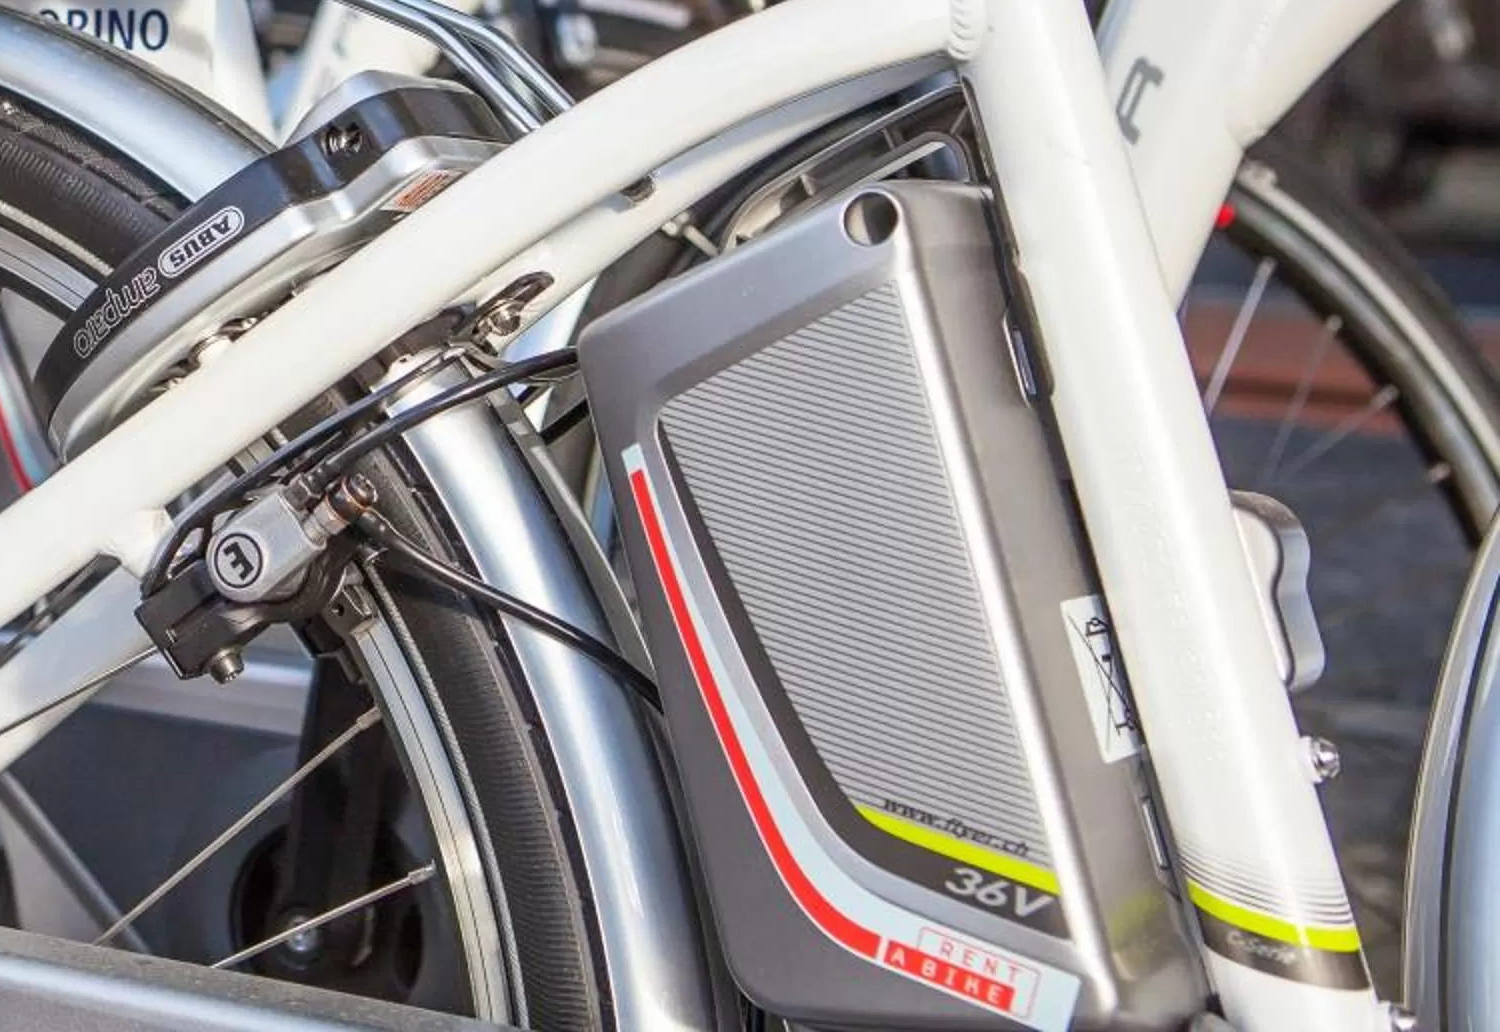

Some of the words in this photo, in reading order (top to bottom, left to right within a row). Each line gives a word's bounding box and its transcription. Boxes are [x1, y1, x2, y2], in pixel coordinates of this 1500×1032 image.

[169, 214, 234, 270] ABUS
[74, 266, 161, 358] amparo
[943, 868, 1056, 917] 36V
[889, 948, 906, 967] A
[939, 934, 1020, 982] RENT
